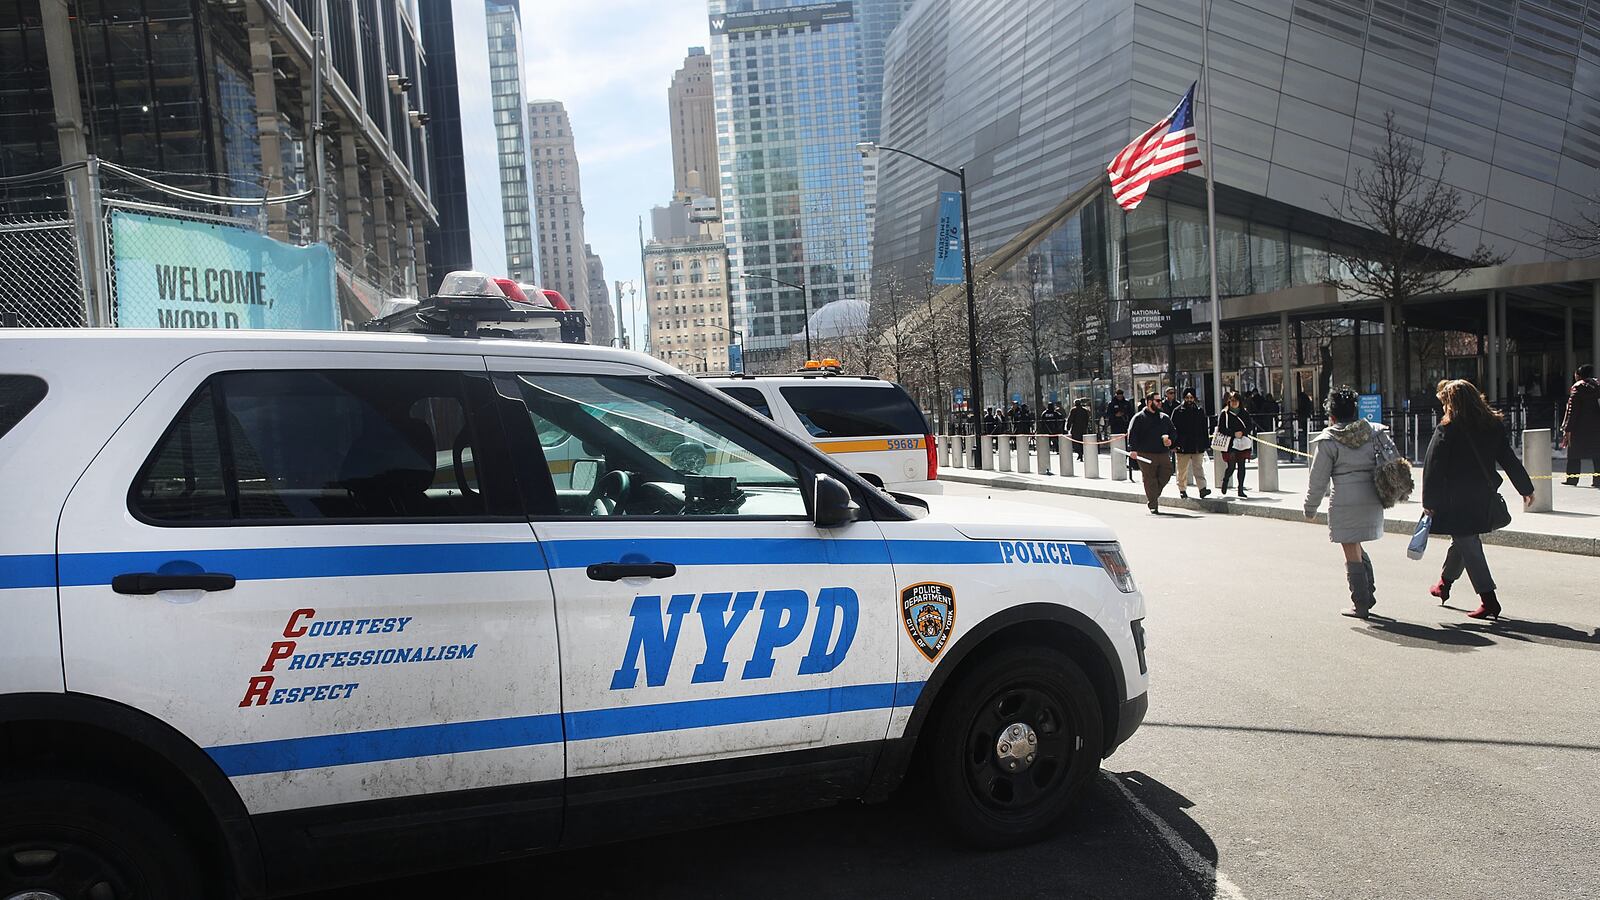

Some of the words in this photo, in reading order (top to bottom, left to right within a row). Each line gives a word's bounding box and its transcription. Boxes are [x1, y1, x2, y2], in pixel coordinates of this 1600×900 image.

[712, 20, 724, 30] W
[949, 227, 959, 250] 9/11
[156, 264, 274, 309] WELCOME,
[888, 438, 918, 449] 59687
[1001, 542, 1072, 564] POLICE
[904, 594, 952, 610] DEPARTMENT
[913, 586, 942, 596] POLICE
[282, 608, 412, 638] COURTESY
[906, 618, 918, 636] CITY
[916, 638, 926, 648] OF
[936, 634, 946, 650] NEW
[945, 610, 954, 630] YORK
[610, 586, 860, 690] NYPD
[260, 640, 478, 672] PROFESSIONALISM
[238, 675, 360, 708] RESPECT
